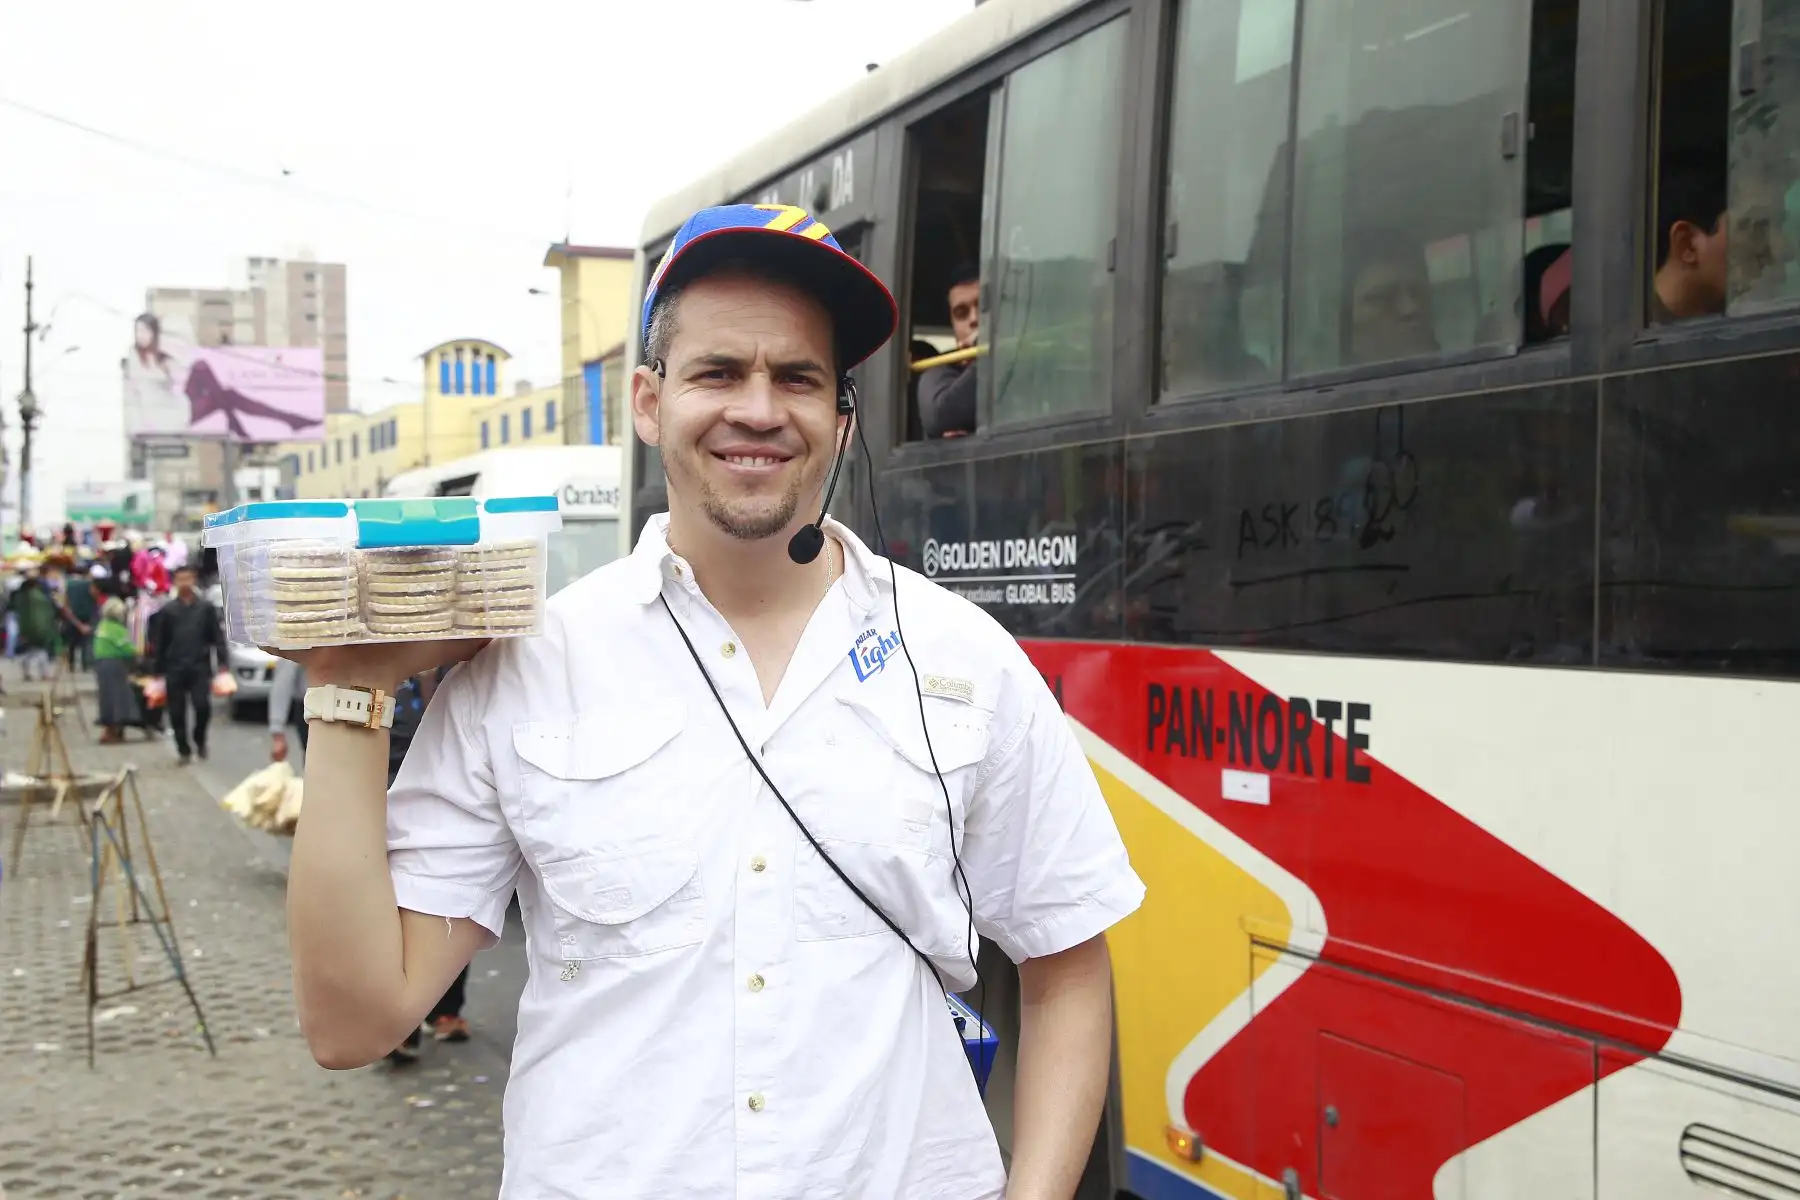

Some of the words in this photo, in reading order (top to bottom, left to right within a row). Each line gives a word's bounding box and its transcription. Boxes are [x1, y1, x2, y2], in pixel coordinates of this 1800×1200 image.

[940, 540, 1000, 572] GOLDEN
[1003, 535, 1077, 569] DRAGON
[1005, 583, 1049, 605] GLOBAL
[1051, 582, 1076, 604] BUS
[848, 630, 901, 683] Light
[1146, 682, 1372, 785] PAN-NORTE
